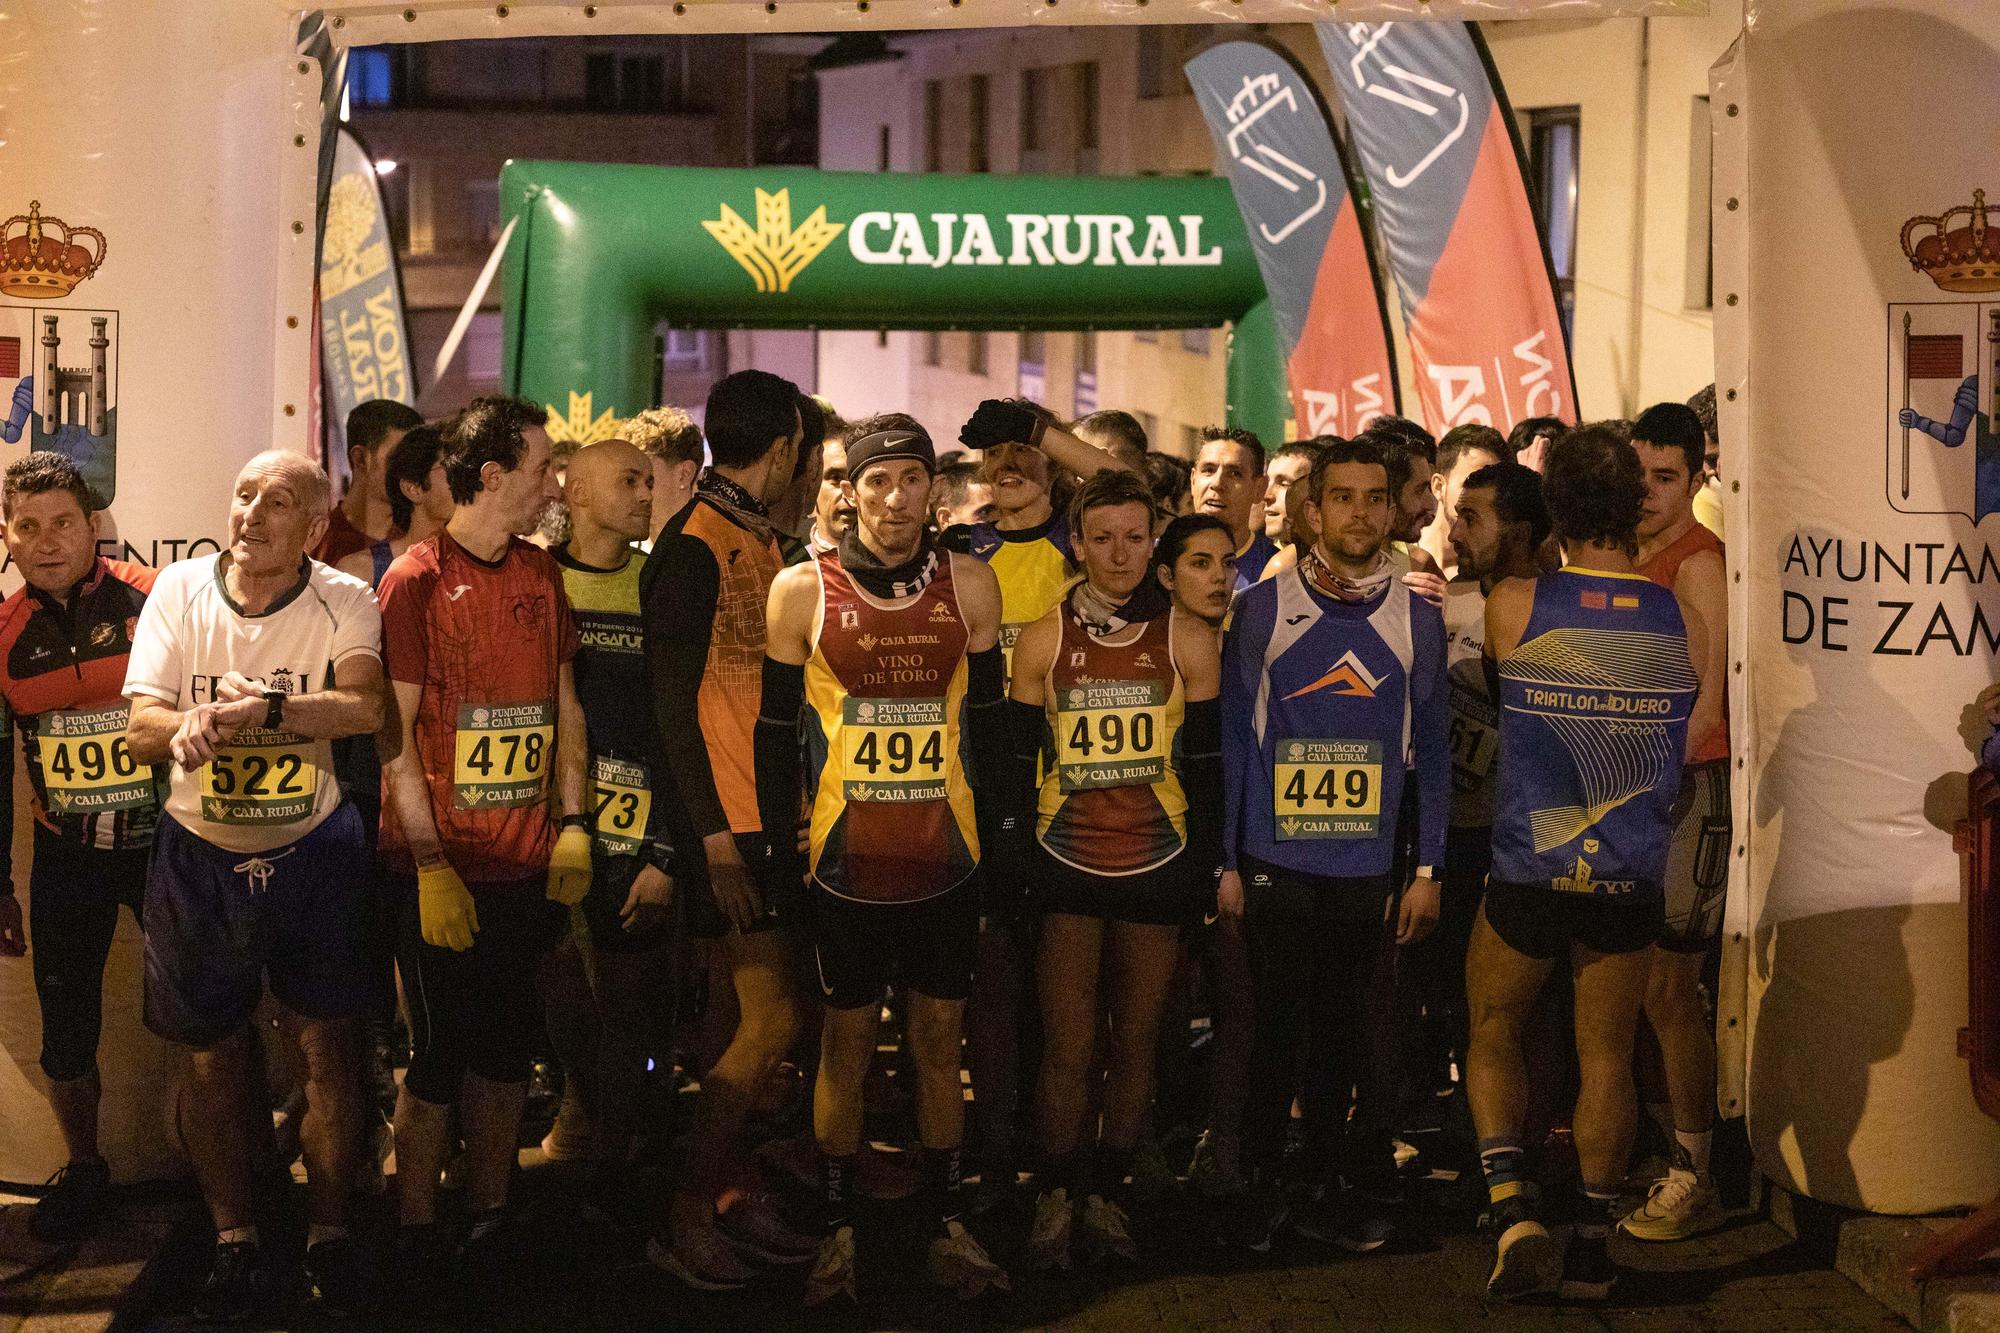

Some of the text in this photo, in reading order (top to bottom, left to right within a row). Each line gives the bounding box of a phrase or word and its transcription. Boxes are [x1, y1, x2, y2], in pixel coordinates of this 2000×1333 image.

[848, 211, 1222, 267] CAJA RURAL
[1783, 590, 1848, 651] DE
[880, 635, 940, 646] CAJA RURAL
[878, 654, 923, 668] VINO
[863, 669, 938, 686] DE TORO
[1088, 686, 1151, 698] FUNDACION
[878, 703, 942, 714] FUNDACION
[1088, 695, 1151, 708] CAJA RURAL
[65, 709, 128, 726] FUNDACION
[491, 705, 543, 718] FUNDACION
[878, 713, 942, 724] CAJA RURAL
[491, 715, 544, 728] CAJA RURAL
[66, 725, 92, 736] CAJA
[1069, 712, 1153, 756] 490
[261, 734, 299, 745] RURAL
[466, 732, 544, 776] 478
[853, 730, 944, 774] 494
[1307, 744, 1369, 754] FUNDACION
[51, 736, 138, 781] 496
[1307, 753, 1368, 762] CAJA RURAL
[211, 753, 303, 795] 522
[1090, 765, 1159, 781] CAJA RURAL
[615, 774, 643, 788] RURAL
[1283, 768, 1369, 808] 449
[74, 788, 148, 806] CAJA RURAL
[486, 790, 514, 801] CAJA
[875, 789, 907, 801] CAJA
[232, 803, 309, 818] CAJA RURAL
[1302, 822, 1373, 832] CAJA RURAL
